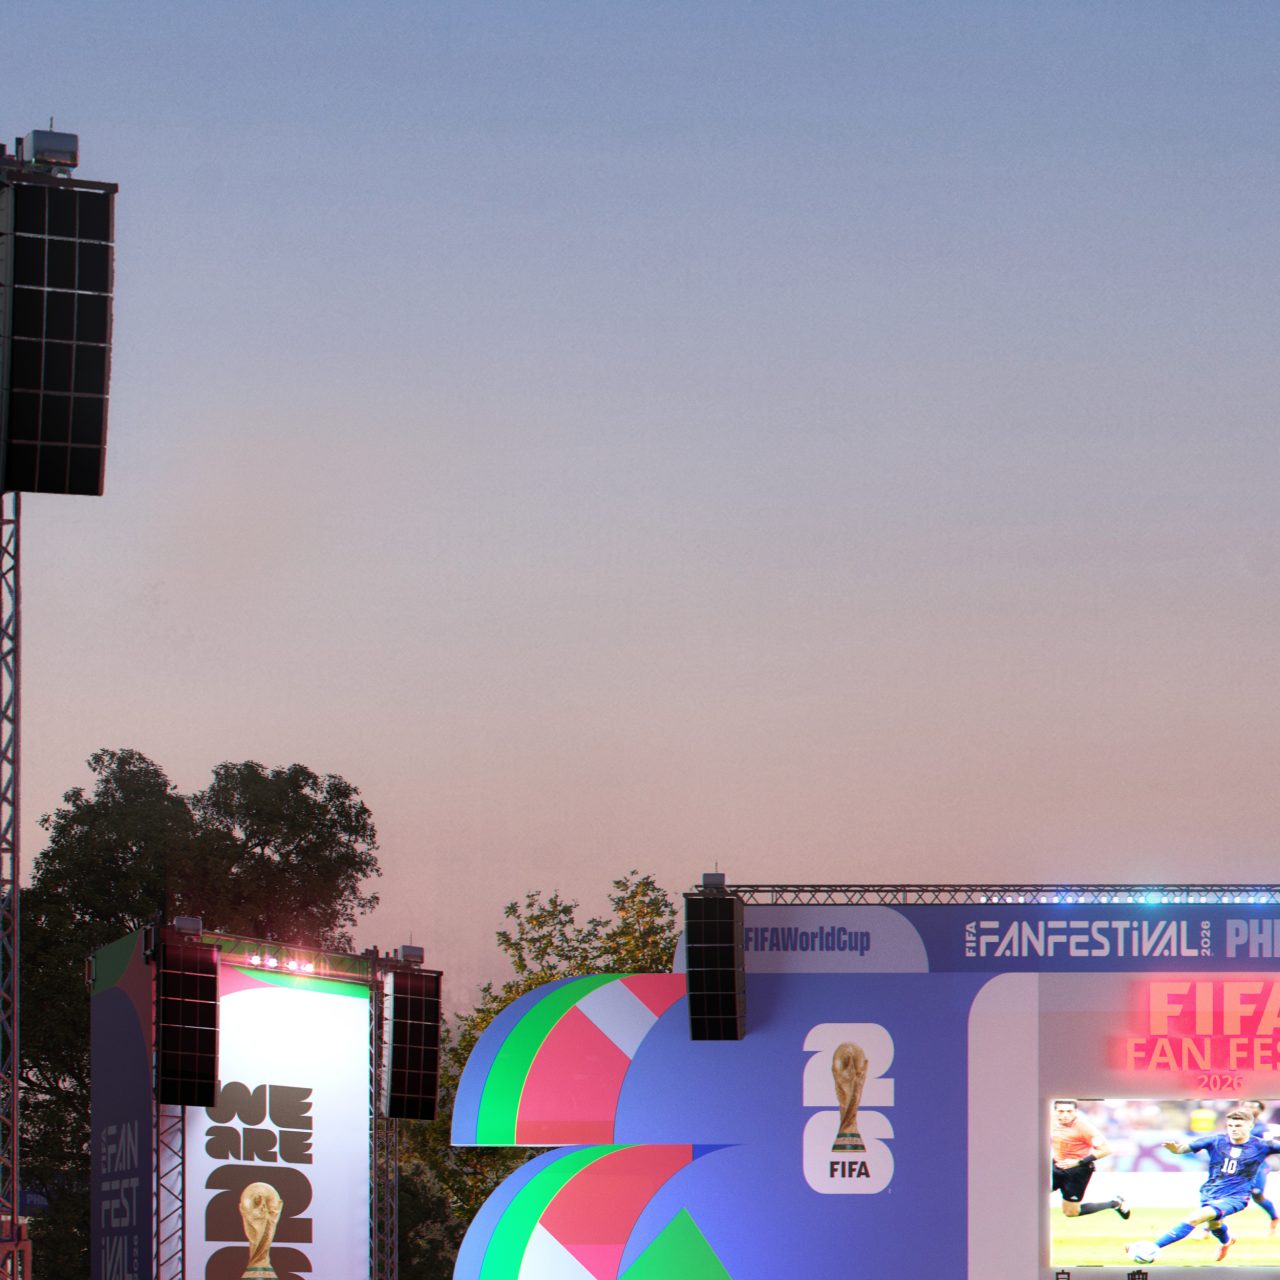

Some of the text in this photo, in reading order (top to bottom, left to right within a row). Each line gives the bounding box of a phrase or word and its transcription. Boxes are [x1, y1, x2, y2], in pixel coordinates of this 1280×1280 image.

[965, 921, 977, 957] FIFA
[1201, 920, 1211, 957] 2026
[1126, 1038, 1212, 1072] FAN
[1198, 1074, 1244, 1092] 2026
[205, 1081, 313, 1130] WE
[829, 1161, 871, 1178] FIFA
[1221, 1158, 1237, 1174] 10
